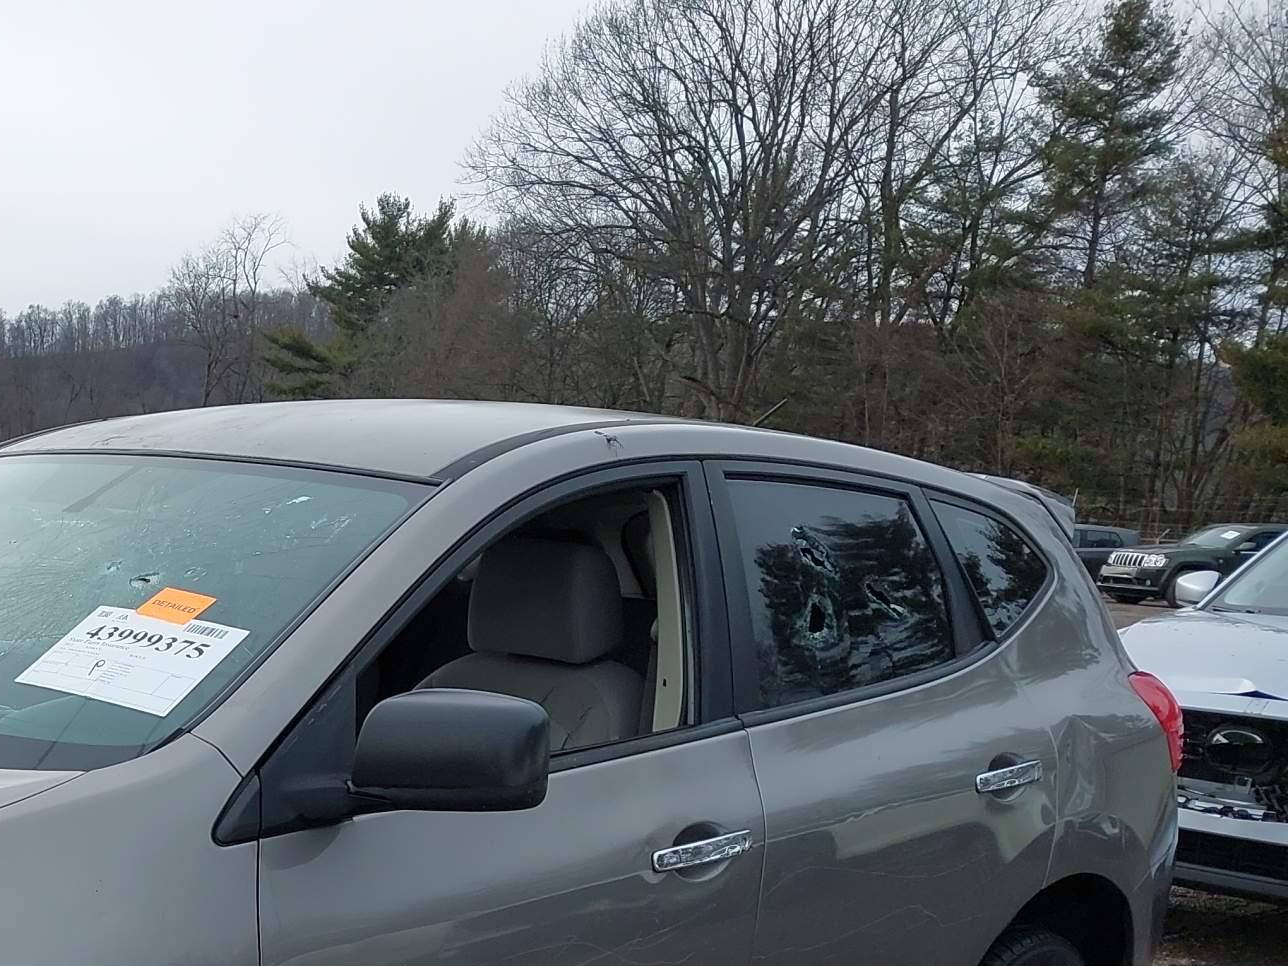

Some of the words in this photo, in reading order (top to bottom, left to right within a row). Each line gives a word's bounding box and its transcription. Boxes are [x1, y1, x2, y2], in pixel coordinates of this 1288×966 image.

[152, 600, 198, 613] DETAILED
[86, 624, 211, 659] 43999375
[101, 641, 130, 651] Insurance
